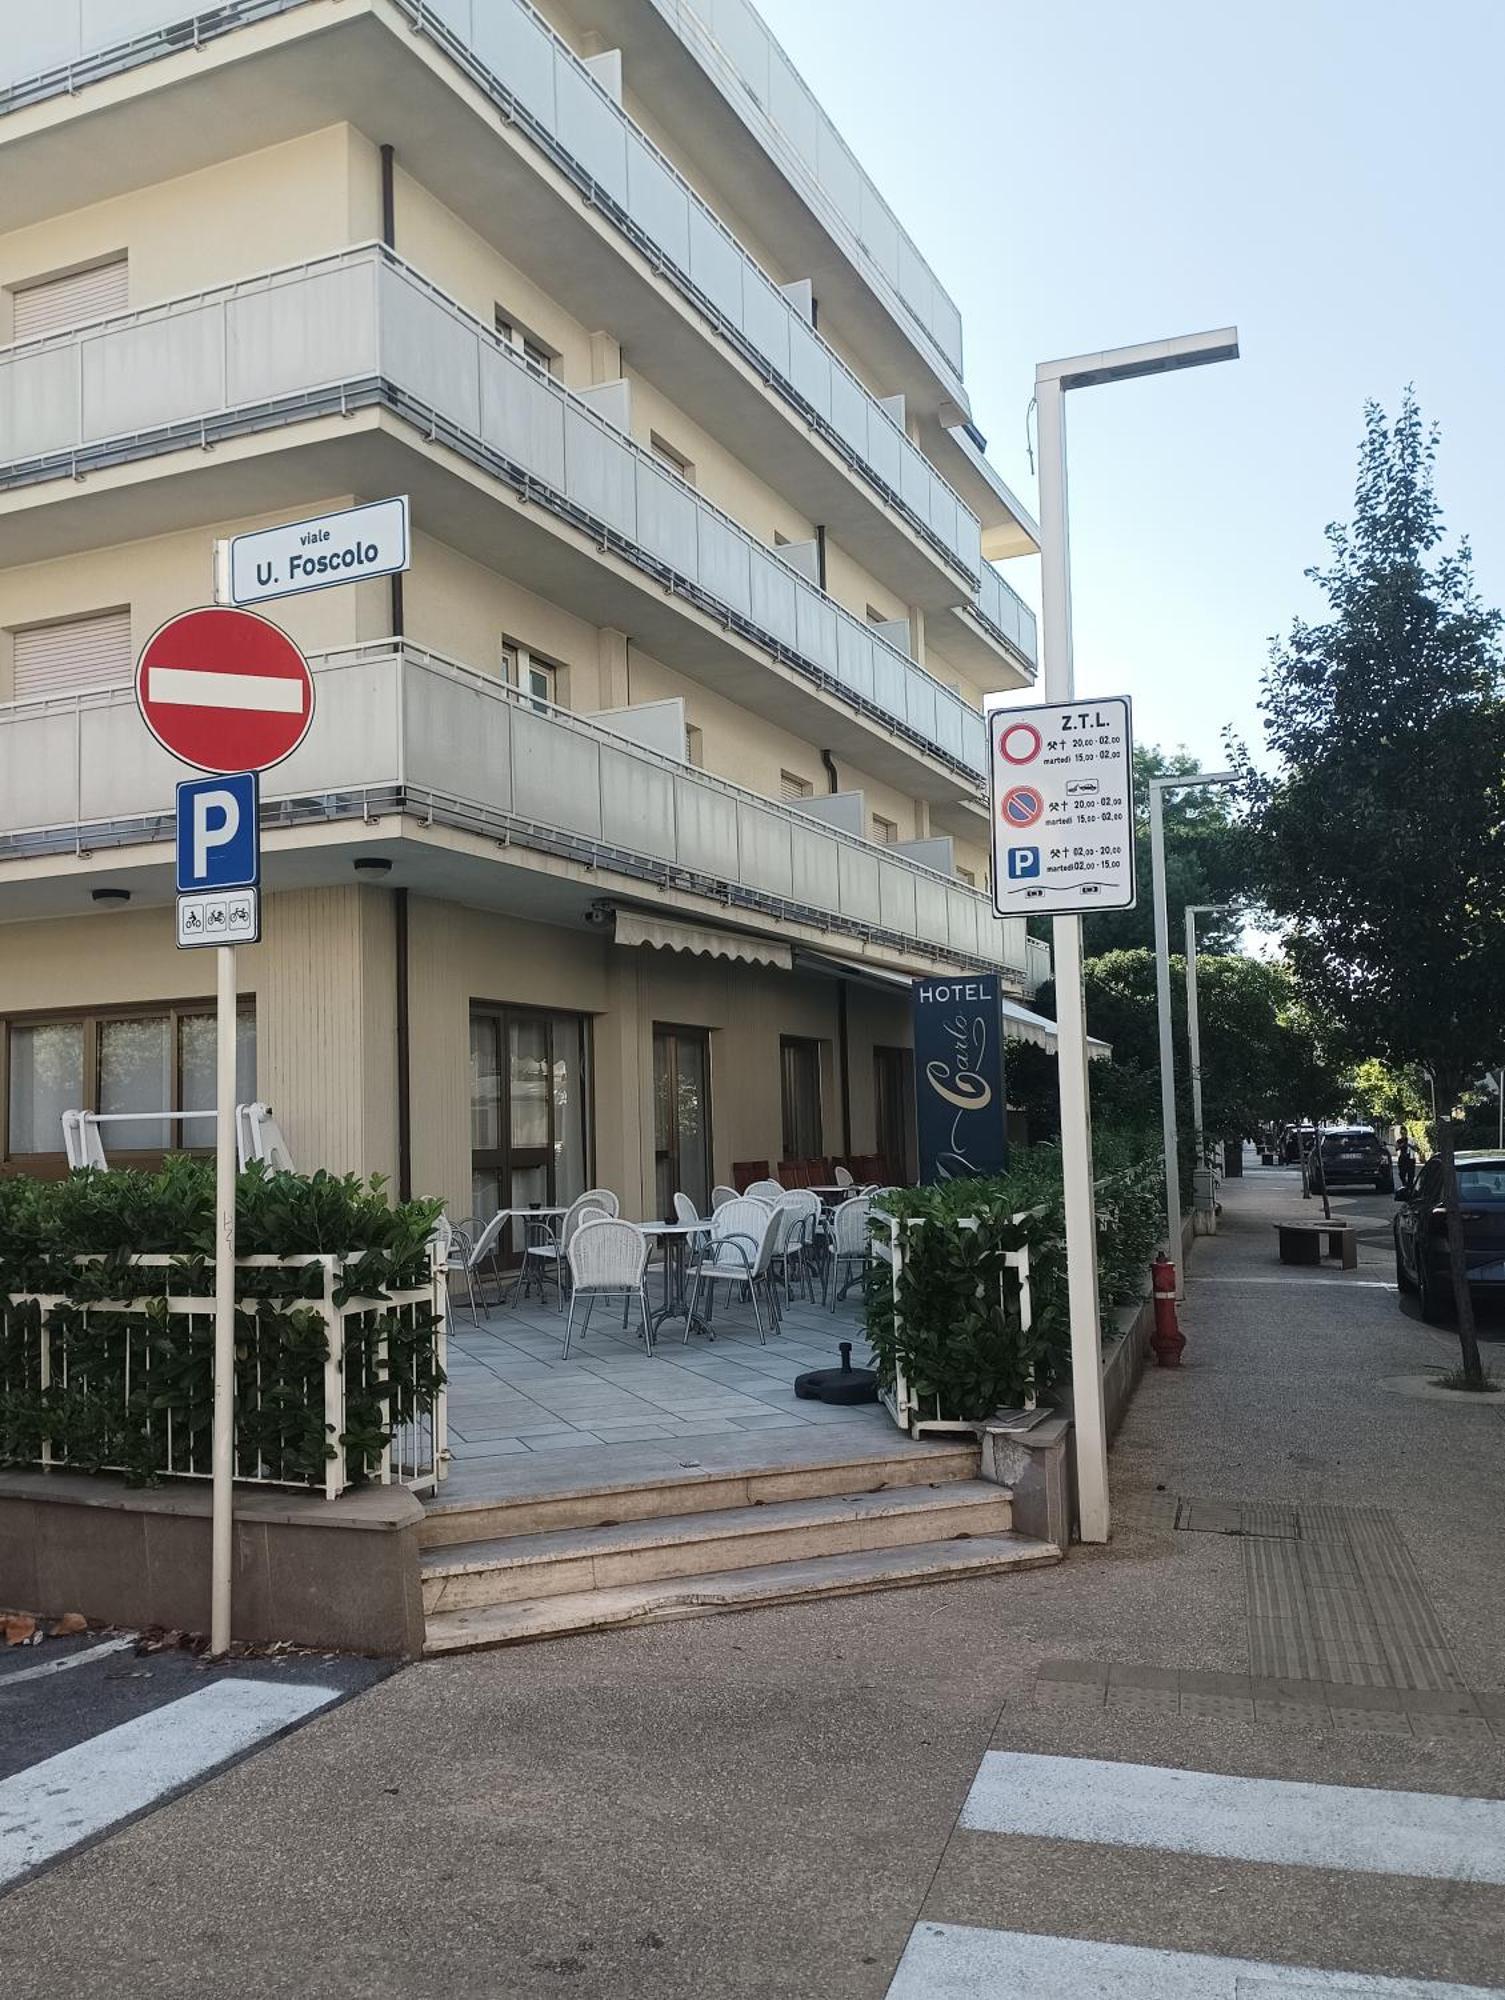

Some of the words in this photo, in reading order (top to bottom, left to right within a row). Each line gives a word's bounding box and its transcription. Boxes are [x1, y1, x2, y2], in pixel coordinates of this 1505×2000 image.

[300, 527, 330, 546] viale
[255, 561, 279, 586] U.
[289, 541, 379, 581] Foscolo
[1061, 711, 1110, 731] Z.T.L.
[193, 789, 240, 879] P
[1015, 850, 1034, 875] P
[919, 983, 992, 1004] HOTEL
[926, 1014, 992, 1111] Carlo
